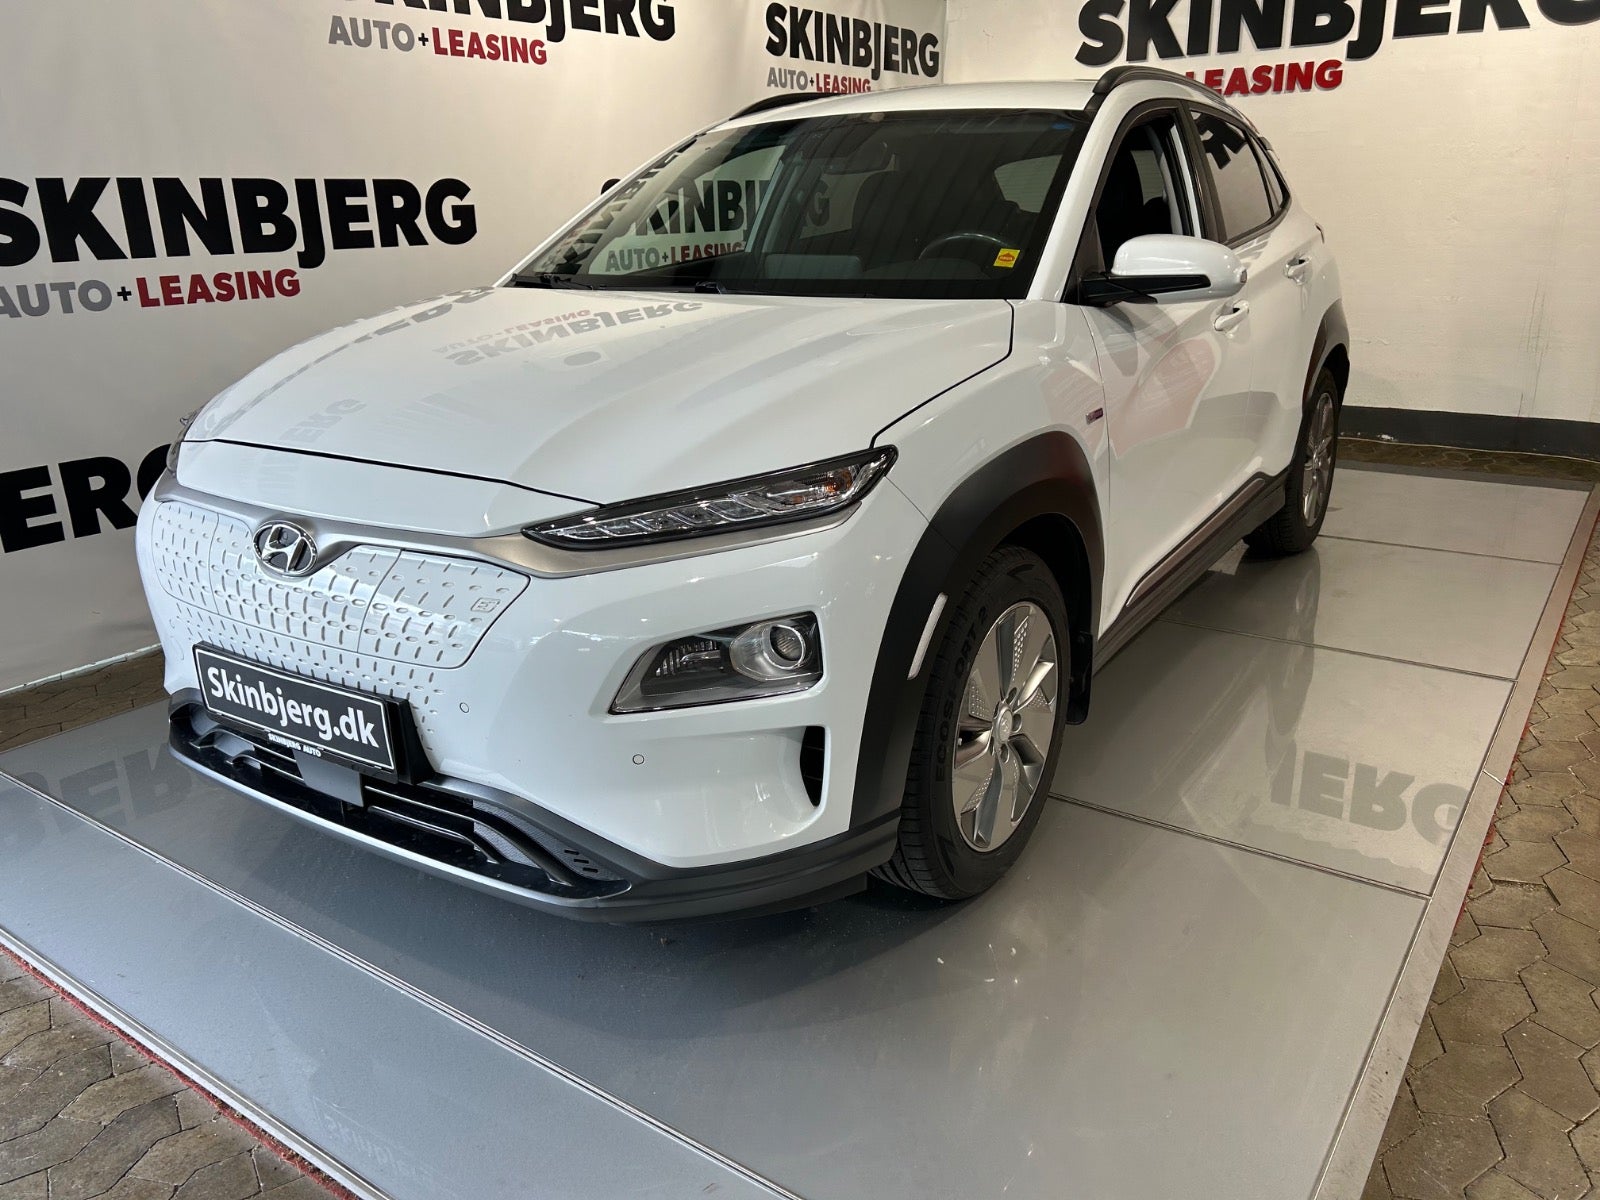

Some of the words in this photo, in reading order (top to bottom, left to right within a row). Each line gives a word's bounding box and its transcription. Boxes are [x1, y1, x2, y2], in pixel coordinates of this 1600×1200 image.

[766, 2, 940, 81] SKINBJERG
[0, 177, 476, 269] SKINBJERG
[207, 667, 380, 749] Skinbjerg.dk
